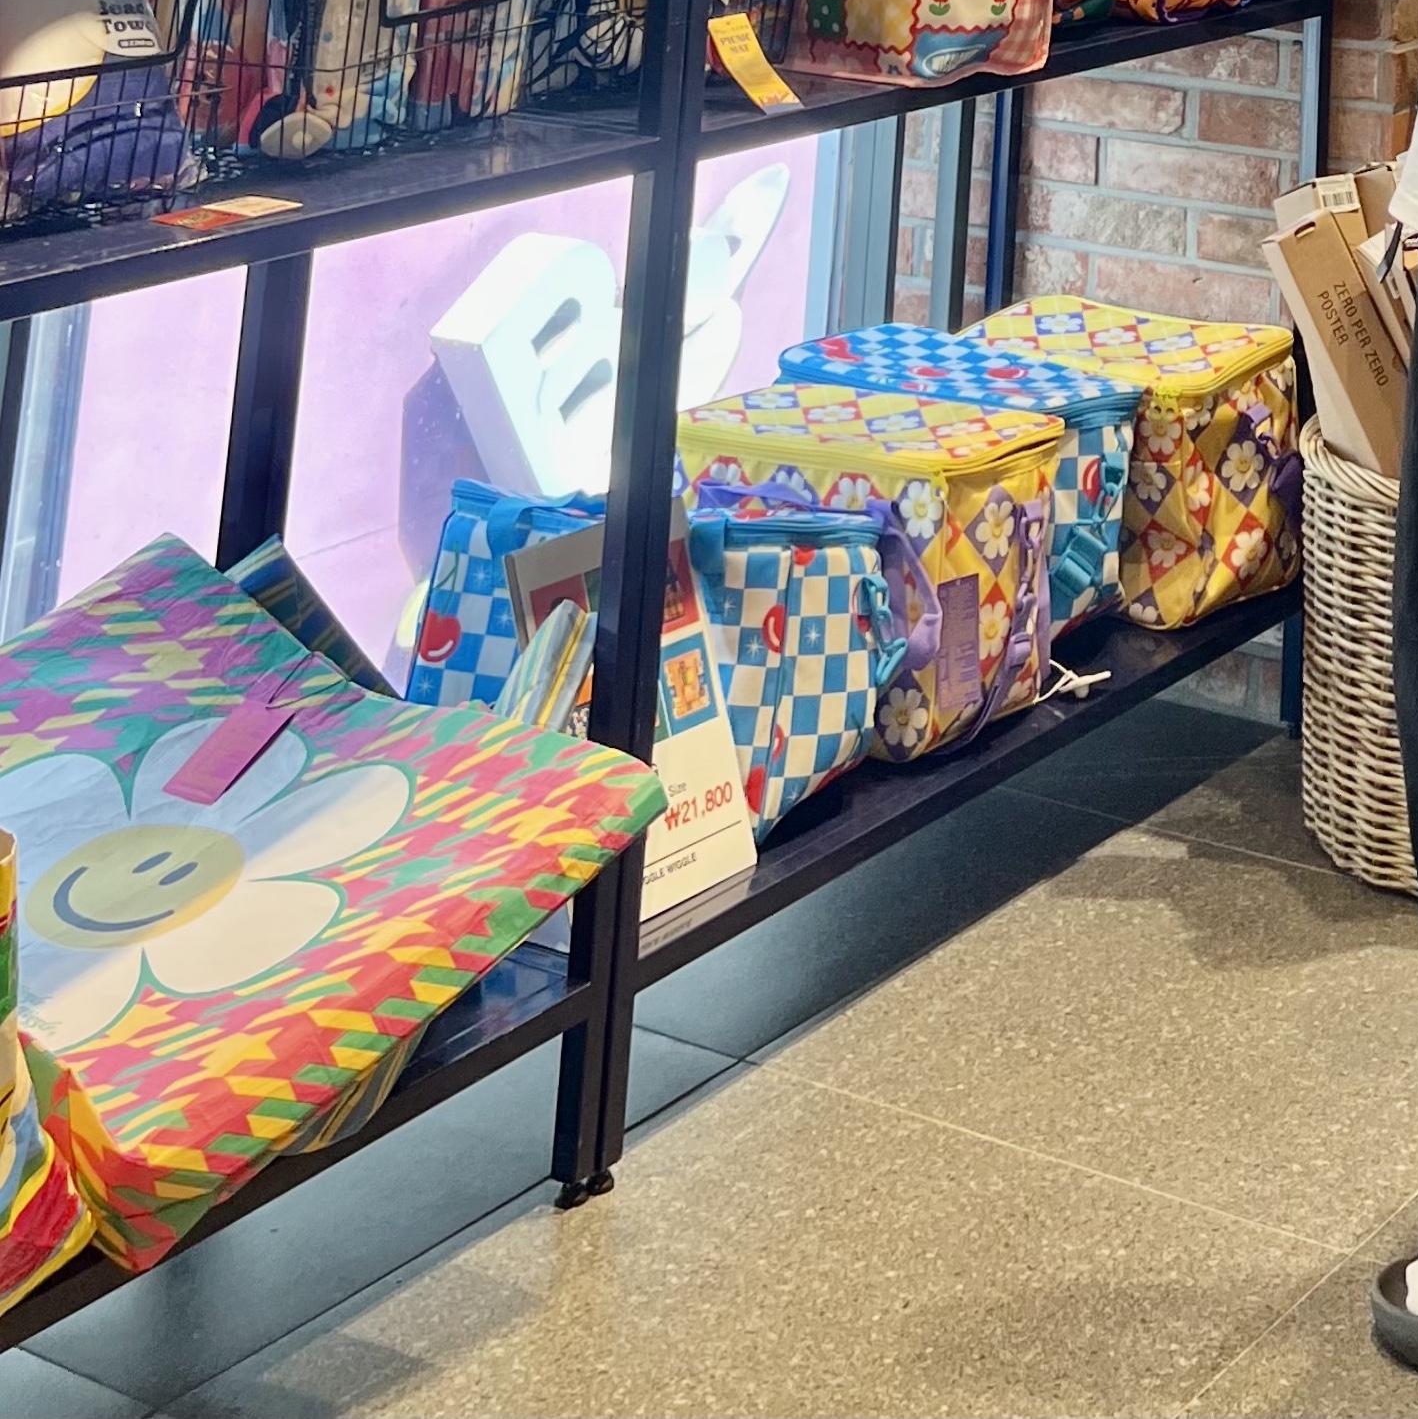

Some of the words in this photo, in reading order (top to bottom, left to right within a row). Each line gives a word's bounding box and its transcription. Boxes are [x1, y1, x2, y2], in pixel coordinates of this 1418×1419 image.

[1317, 290, 1350, 346] POSTER
[1332, 280, 1358, 318] ZERO
[1350, 317, 1372, 349] PER
[1364, 348, 1389, 387] ZERO
[667, 782, 687, 798] Size
